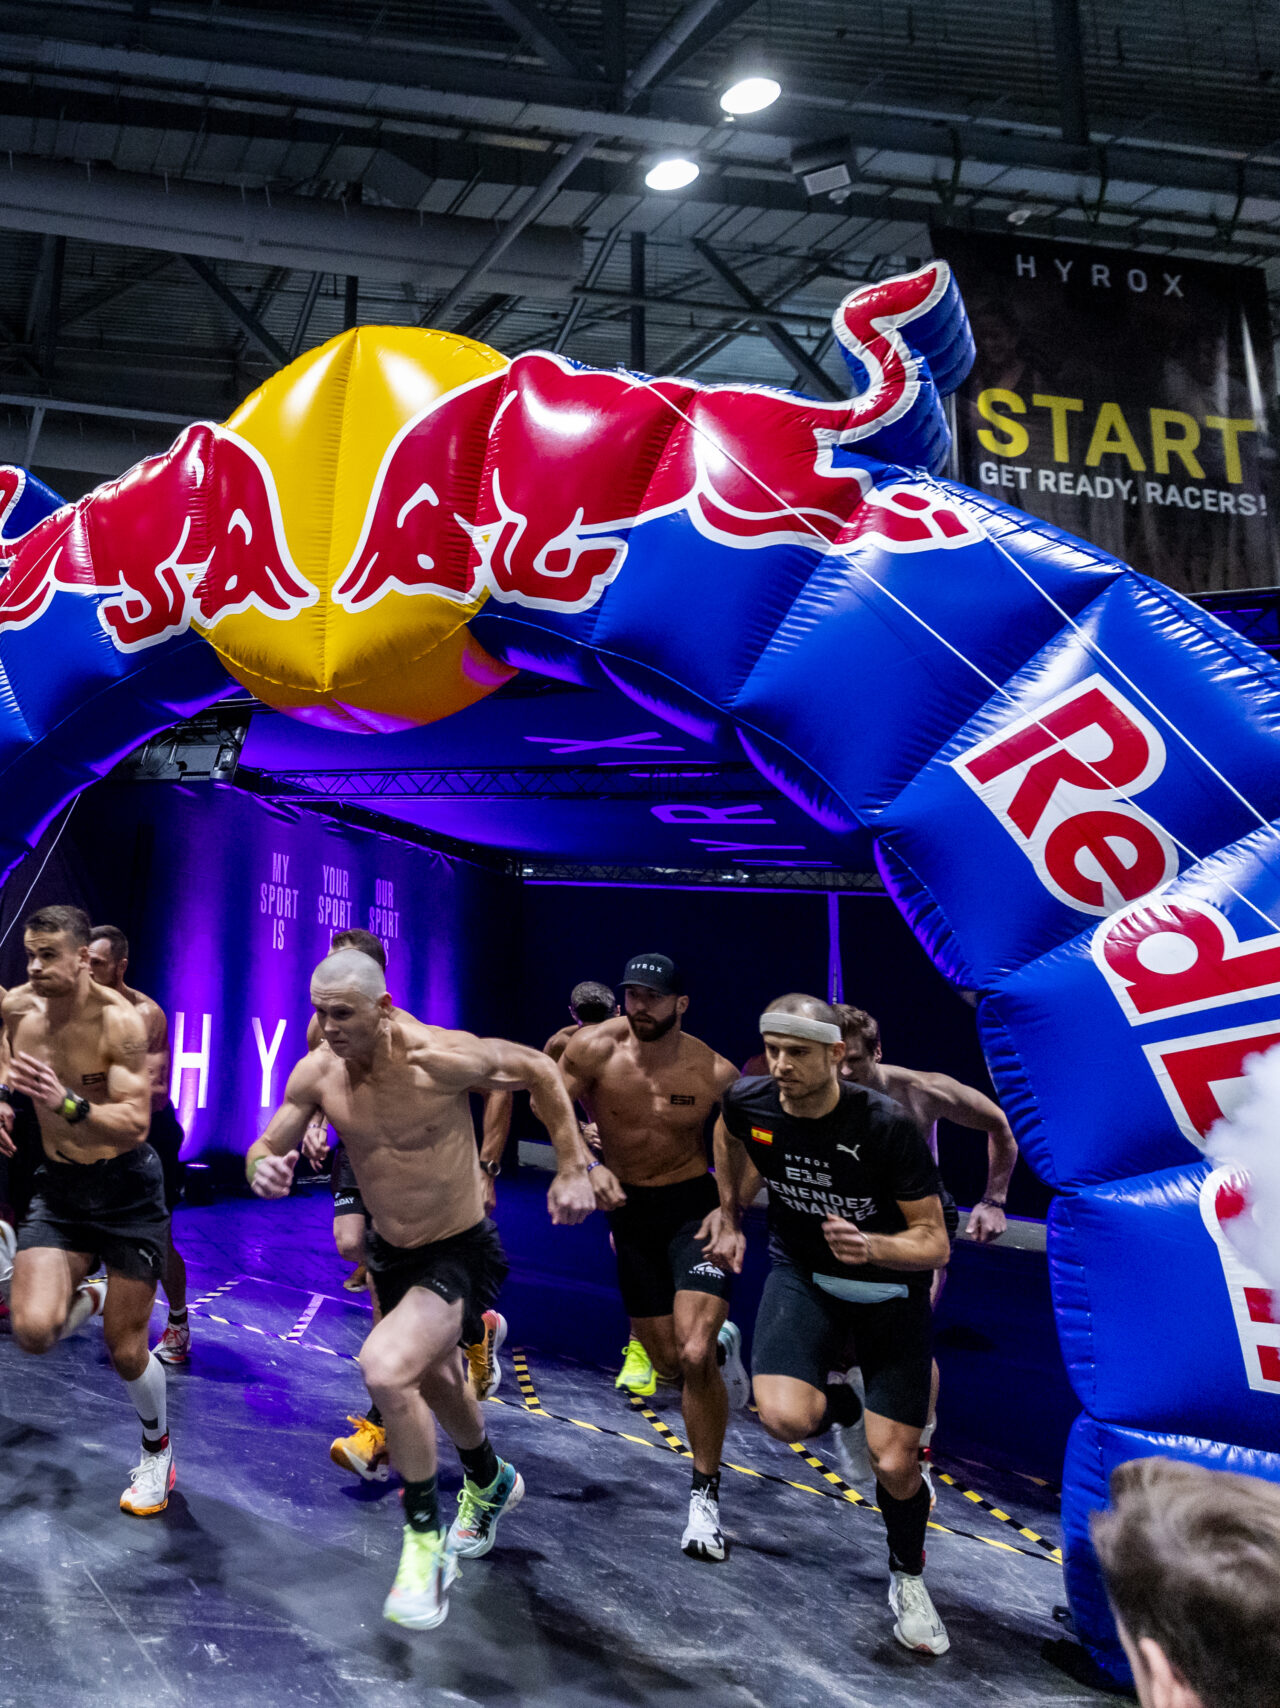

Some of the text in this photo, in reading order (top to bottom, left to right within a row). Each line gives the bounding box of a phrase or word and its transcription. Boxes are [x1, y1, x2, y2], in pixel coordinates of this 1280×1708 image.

[1016, 254, 1184, 298] HYROX
[977, 387, 1257, 485] START
[979, 461, 1268, 517] GET READY, RACERS!
[272, 852, 290, 885] MY
[323, 864, 350, 899] YOUR
[260, 882, 299, 920] SPORT
[375, 877, 394, 909] OUR
[318, 895, 353, 929] SPORT
[369, 906, 400, 939] SPORT
[272, 918, 285, 950] IS
[784, 1153, 830, 1169] HYROX
